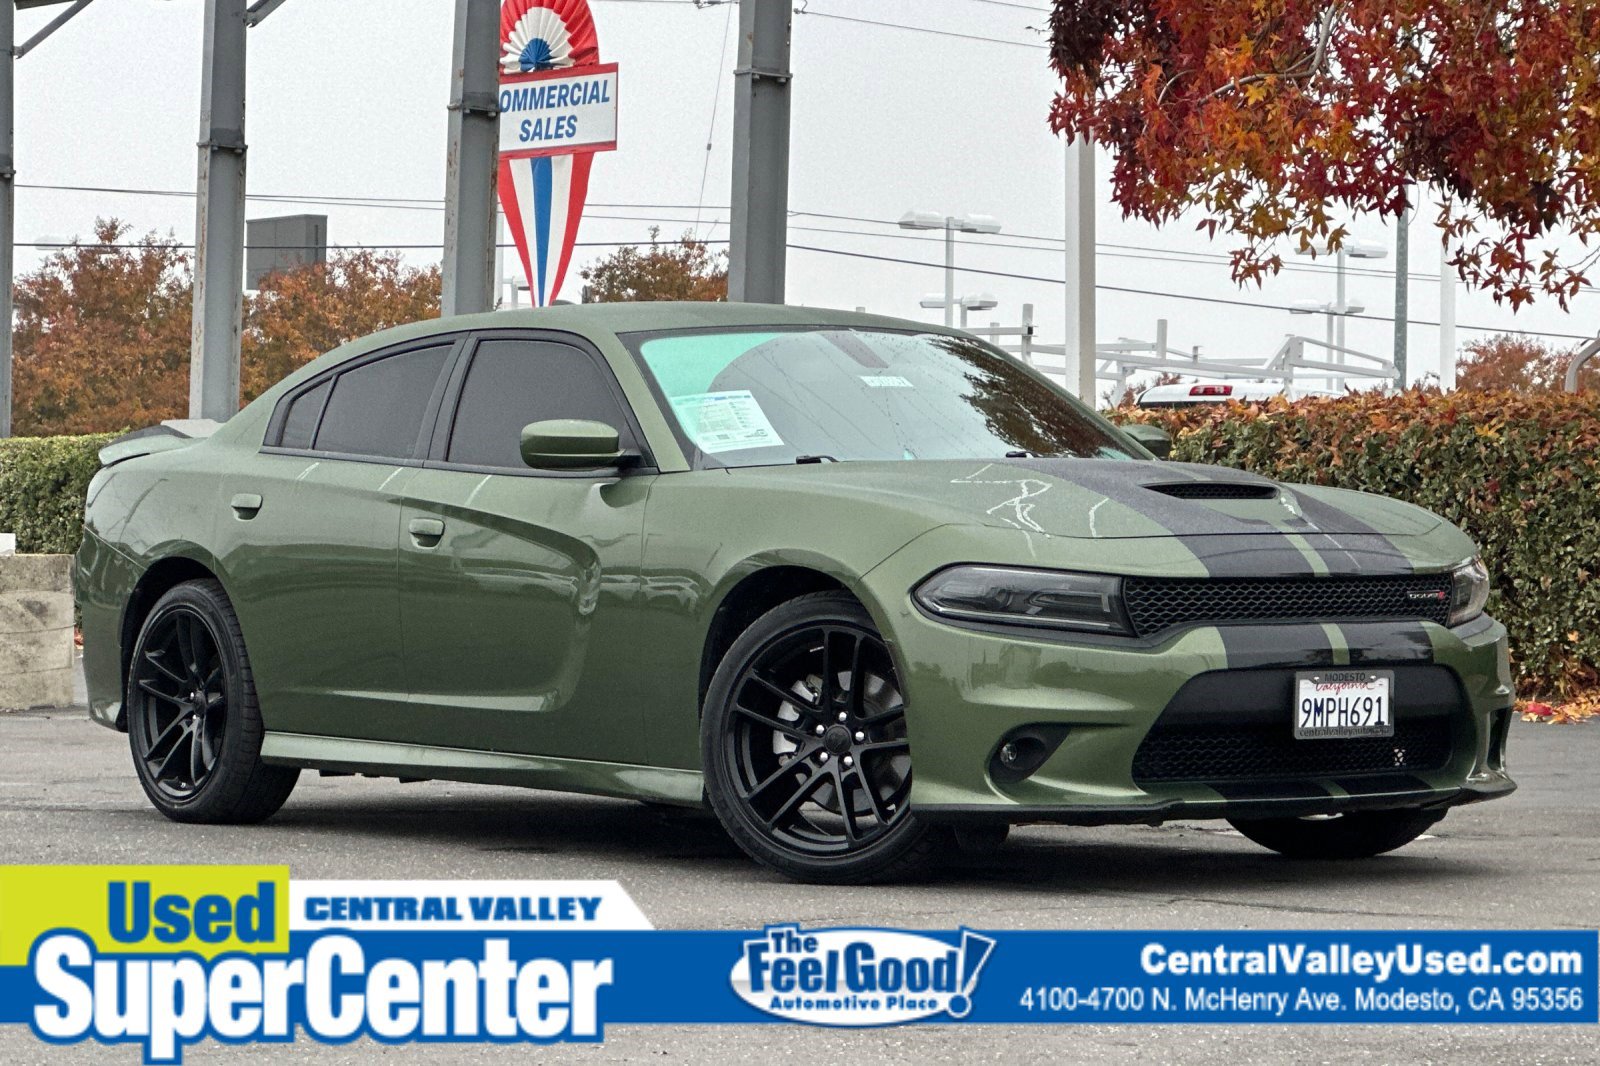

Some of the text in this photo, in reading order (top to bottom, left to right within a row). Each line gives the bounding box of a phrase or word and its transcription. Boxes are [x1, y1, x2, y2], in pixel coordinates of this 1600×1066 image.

[499, 80, 610, 113] OMMERCIAL
[519, 115, 578, 142] SALES
[1325, 672, 1366, 682] MODESTO
[1301, 697, 1385, 726] 9MPH691
